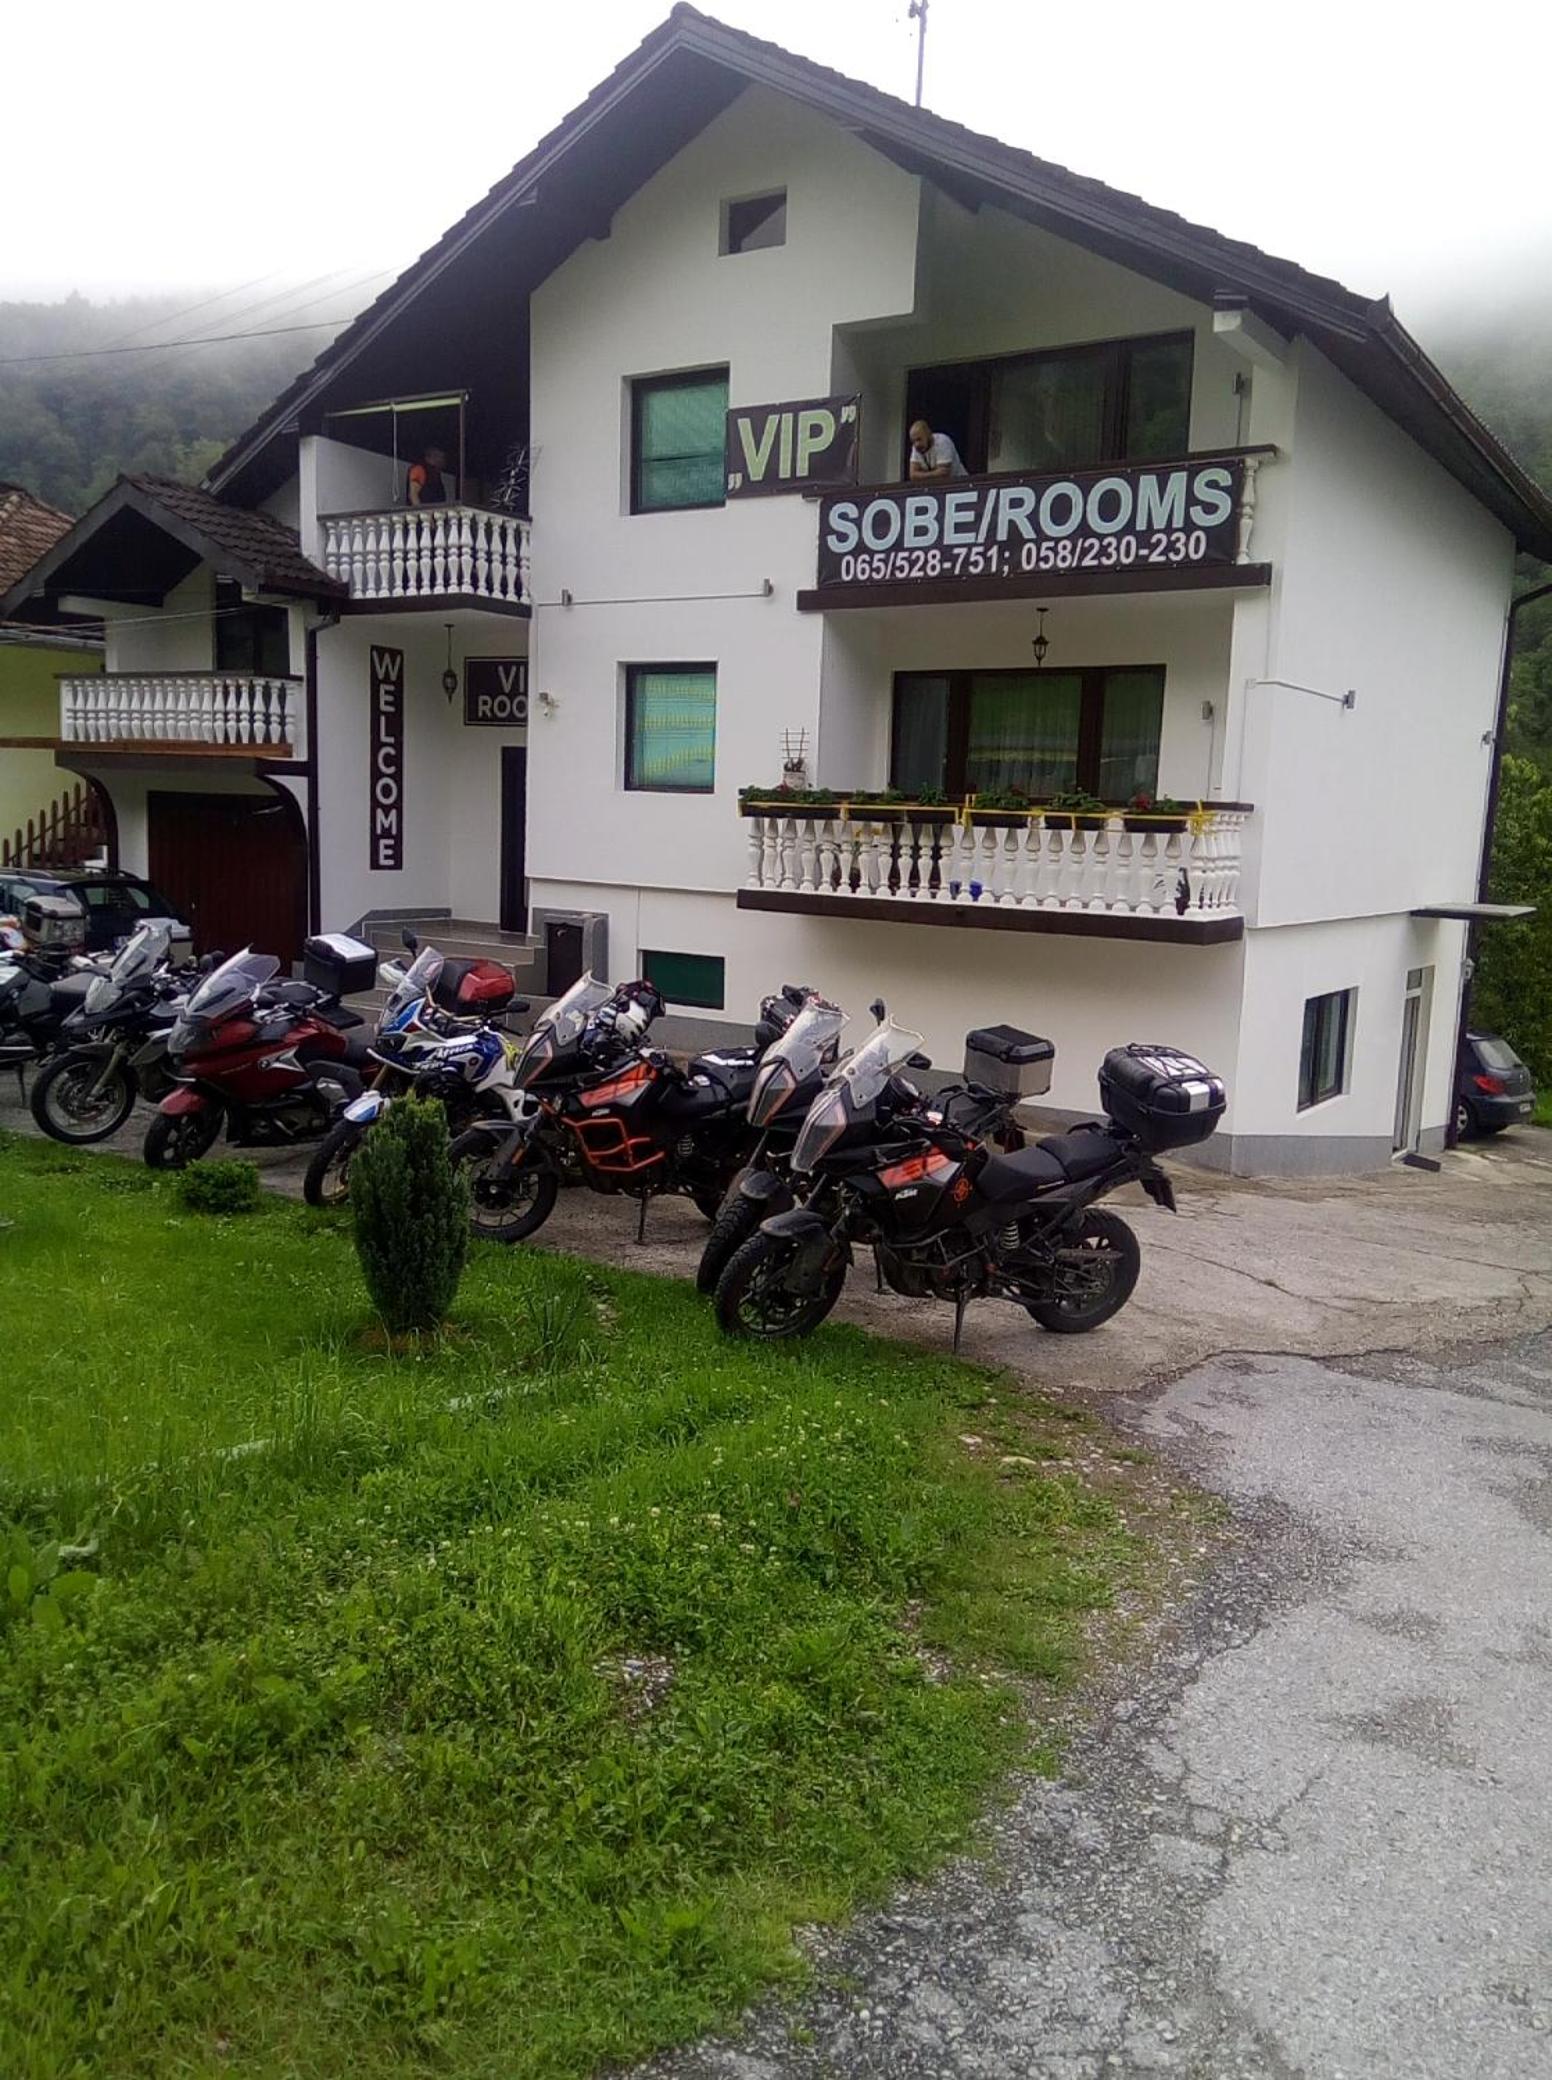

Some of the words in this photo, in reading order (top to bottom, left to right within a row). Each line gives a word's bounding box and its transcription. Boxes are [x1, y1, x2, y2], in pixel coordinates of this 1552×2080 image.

[827, 468, 1232, 553] SOBE/ROOMS
[1021, 531, 1207, 570] 058/230-230
[498, 665, 526, 694] VI
[478, 695, 527, 718] ROO
[372, 650, 401, 866] WELCOME
